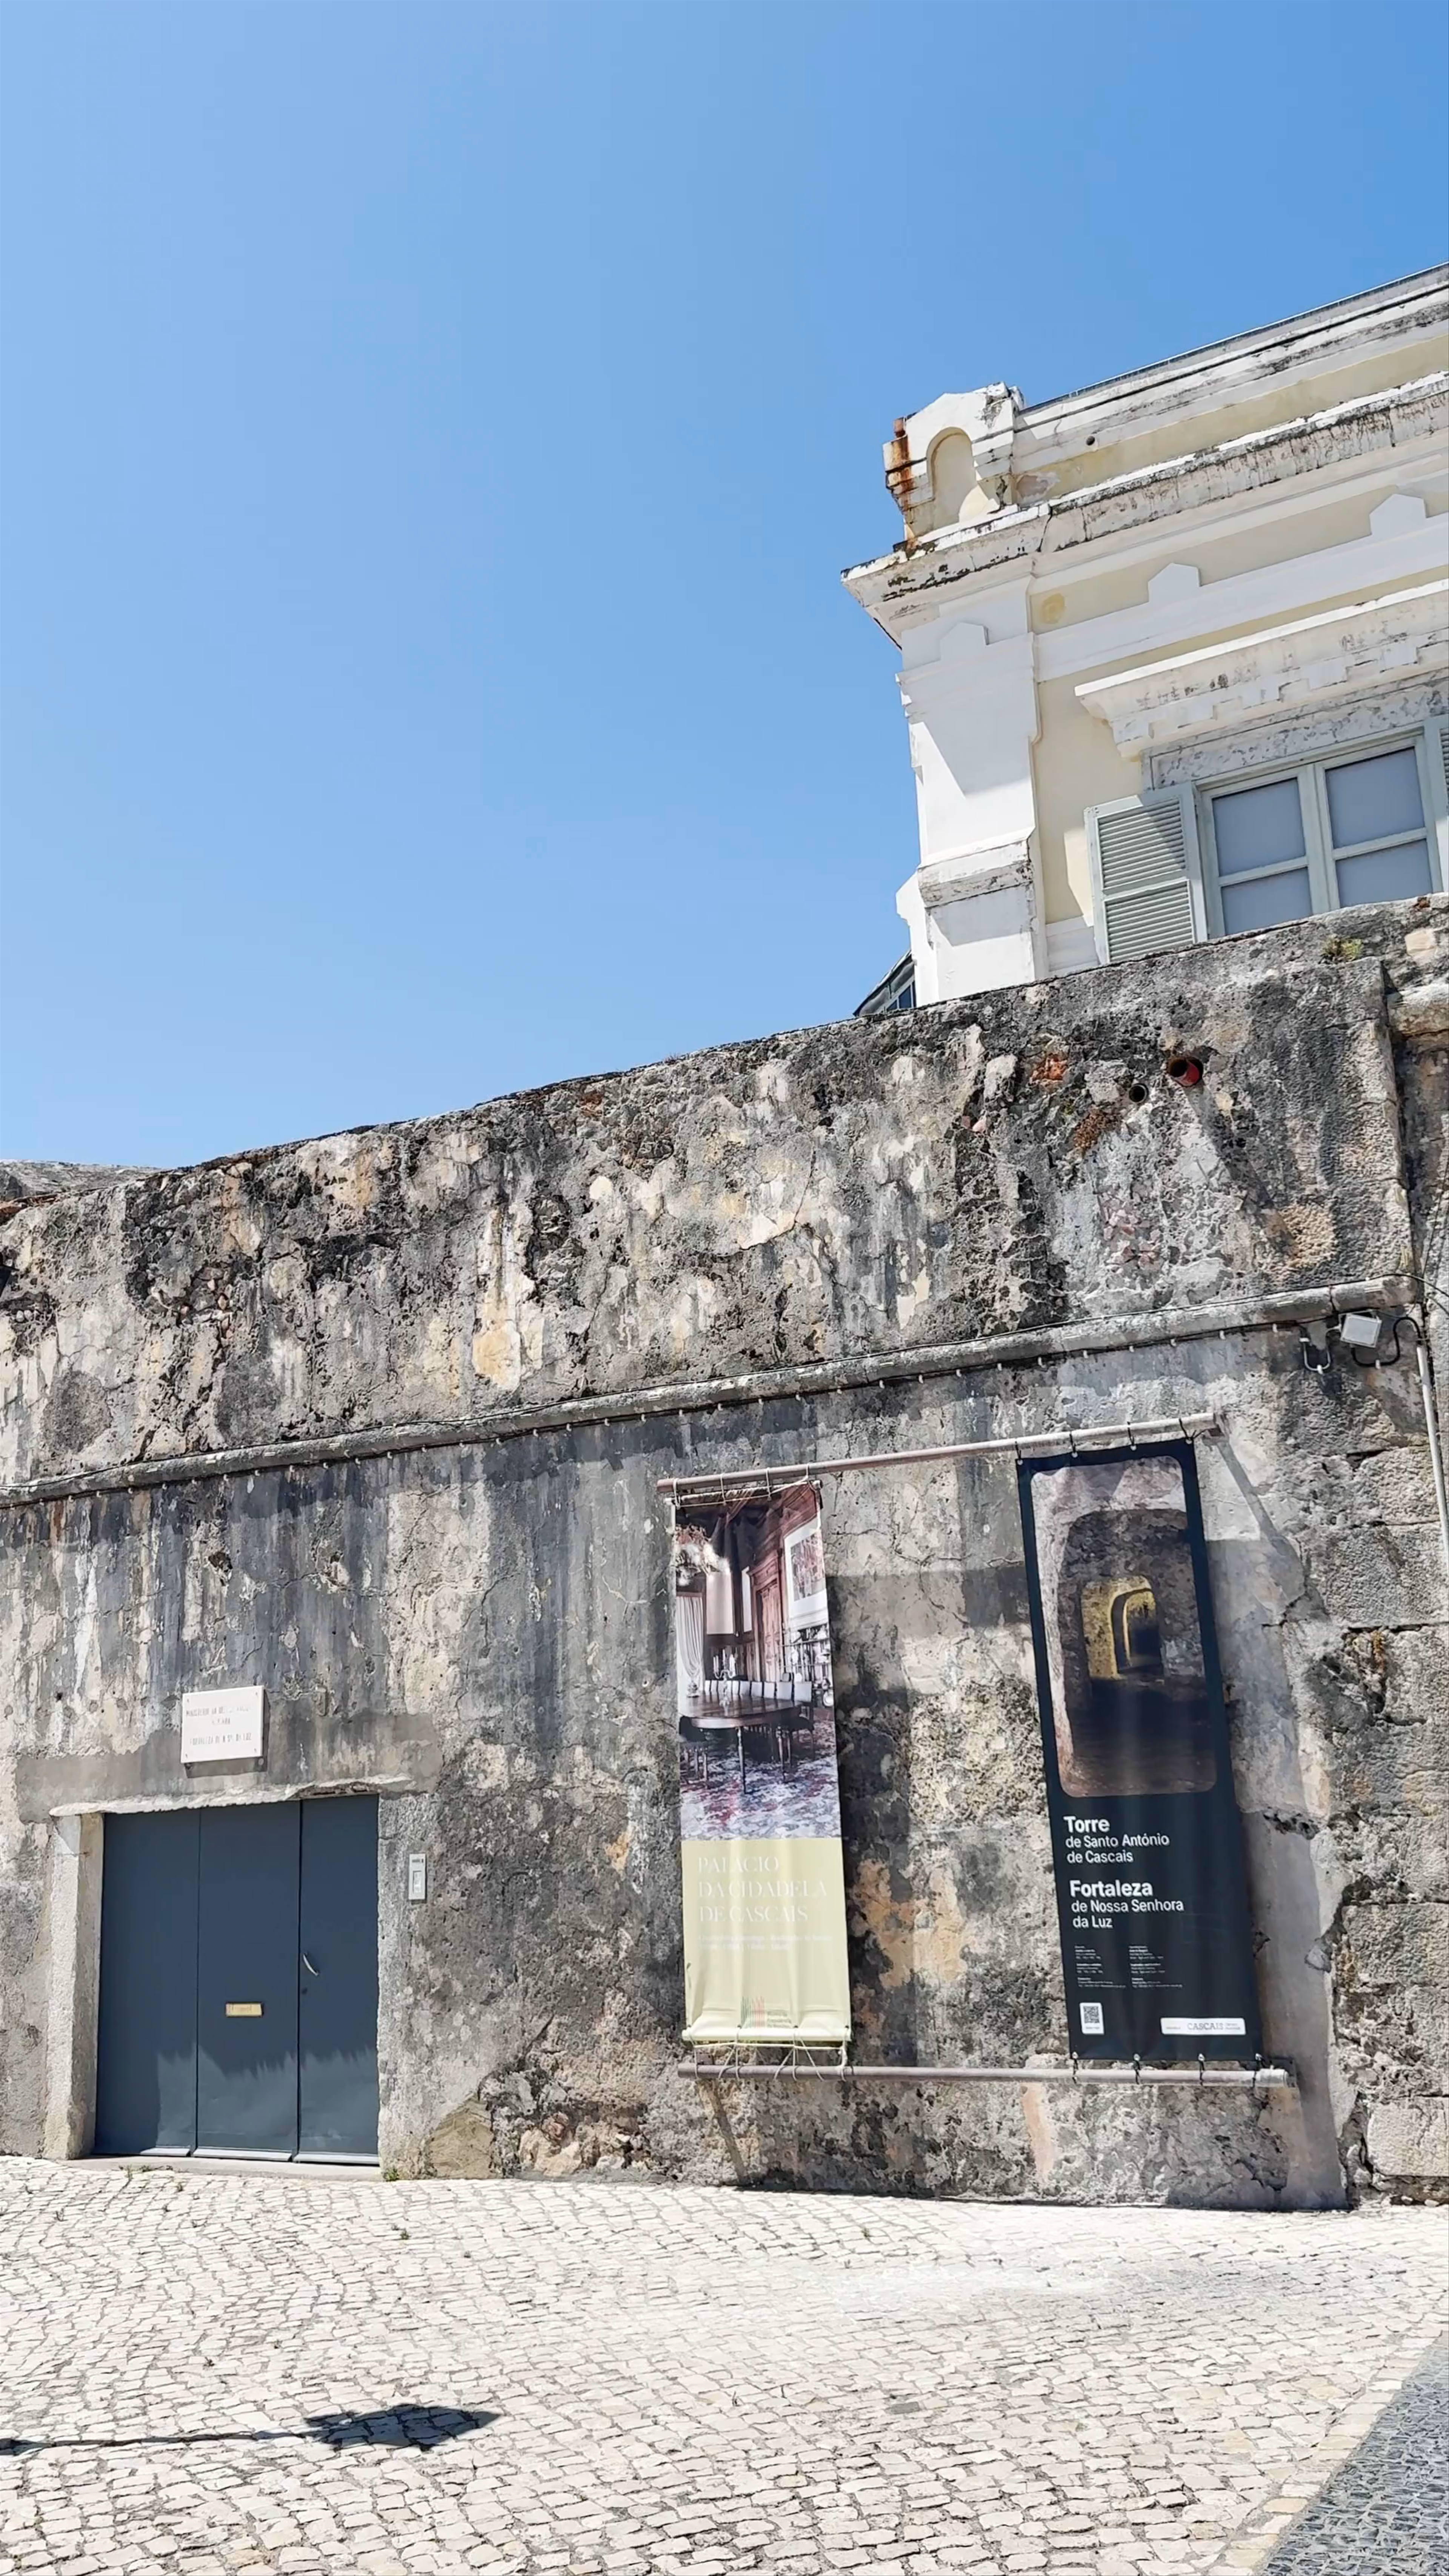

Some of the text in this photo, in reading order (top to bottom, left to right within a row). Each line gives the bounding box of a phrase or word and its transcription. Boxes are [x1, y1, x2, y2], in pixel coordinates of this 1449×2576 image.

[1063, 1816, 1110, 1833] Torre
[1065, 1833, 1170, 1849] de Santo António
[1067, 1850, 1134, 1863] de Cascais
[698, 1880, 827, 1898] DA CIDADELA
[1069, 1879, 1153, 1898] Fortaleza
[699, 1905, 809, 1922] DE CASCAIS
[1071, 1899, 1184, 1913] de Nossa Senhora
[1072, 1915, 1113, 1929] da Luz
